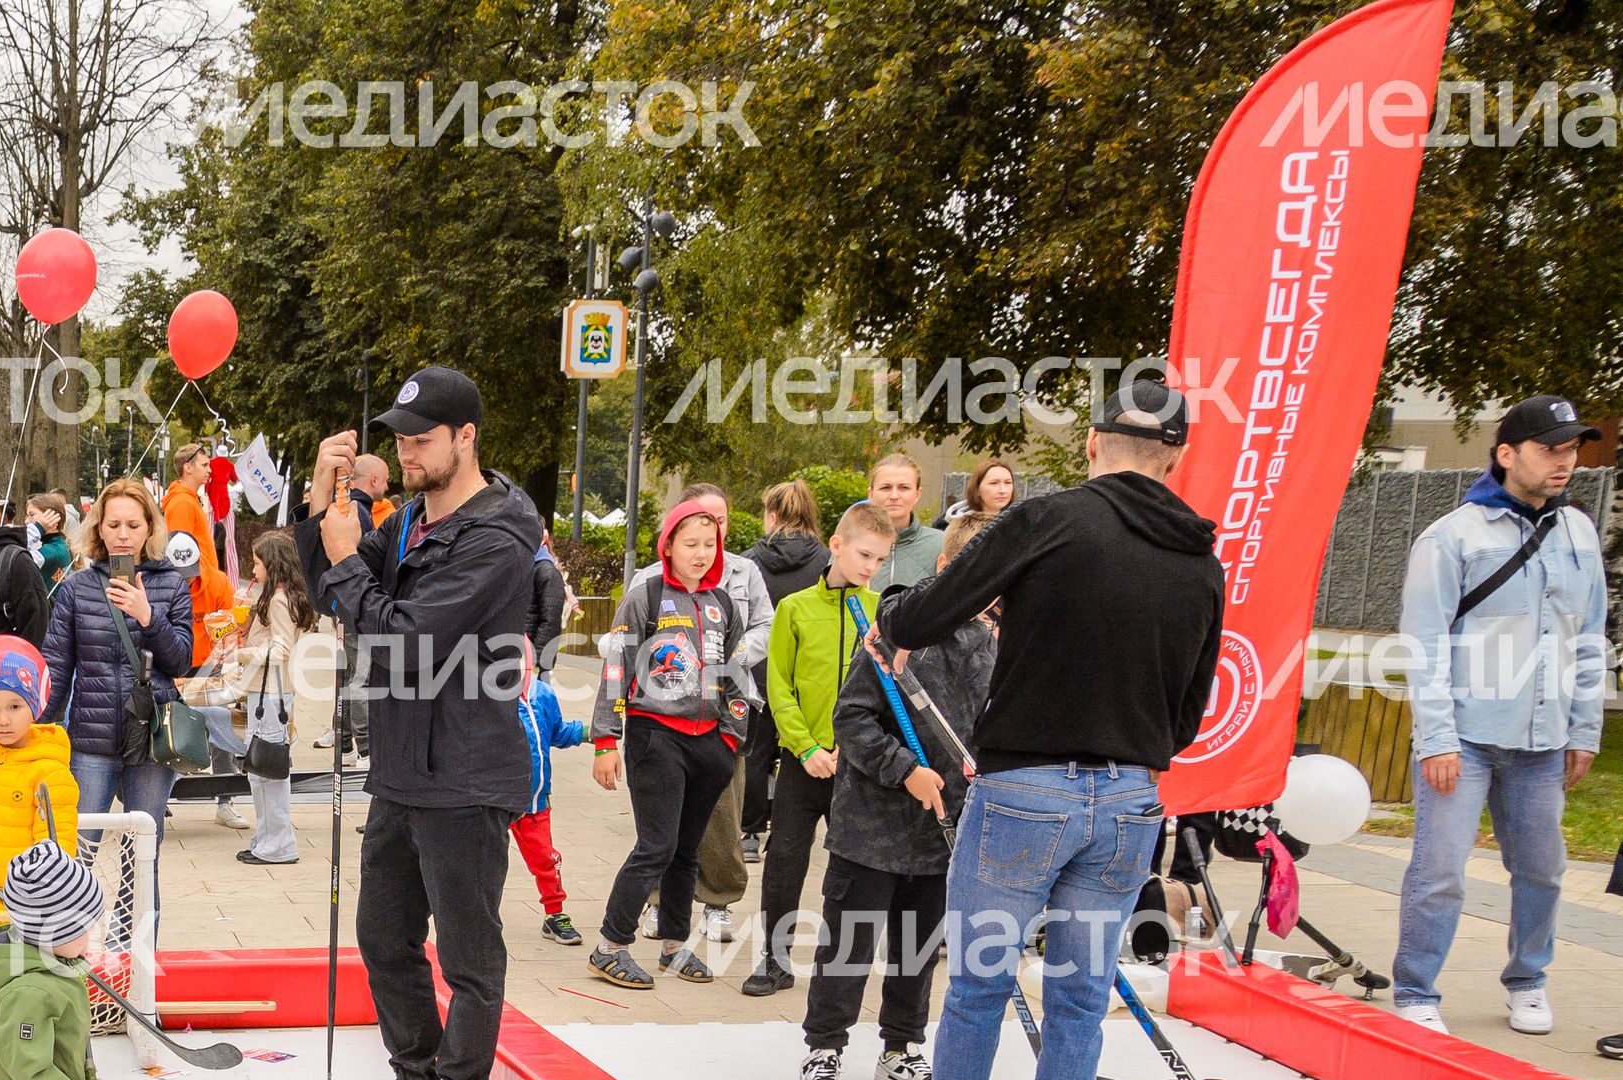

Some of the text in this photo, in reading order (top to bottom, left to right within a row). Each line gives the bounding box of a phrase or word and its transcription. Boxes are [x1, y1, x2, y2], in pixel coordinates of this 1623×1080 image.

[1214, 151, 1319, 584] ПОРТВСЕГДА
[1230, 150, 1351, 605] СПОРТИВНЫЕ КОМПЛЕКСЫ
[1223, 639, 1255, 678] НАМИ
[1206, 700, 1252, 751] ИГРАЙ
[1012, 980, 1037, 1035] AUER
